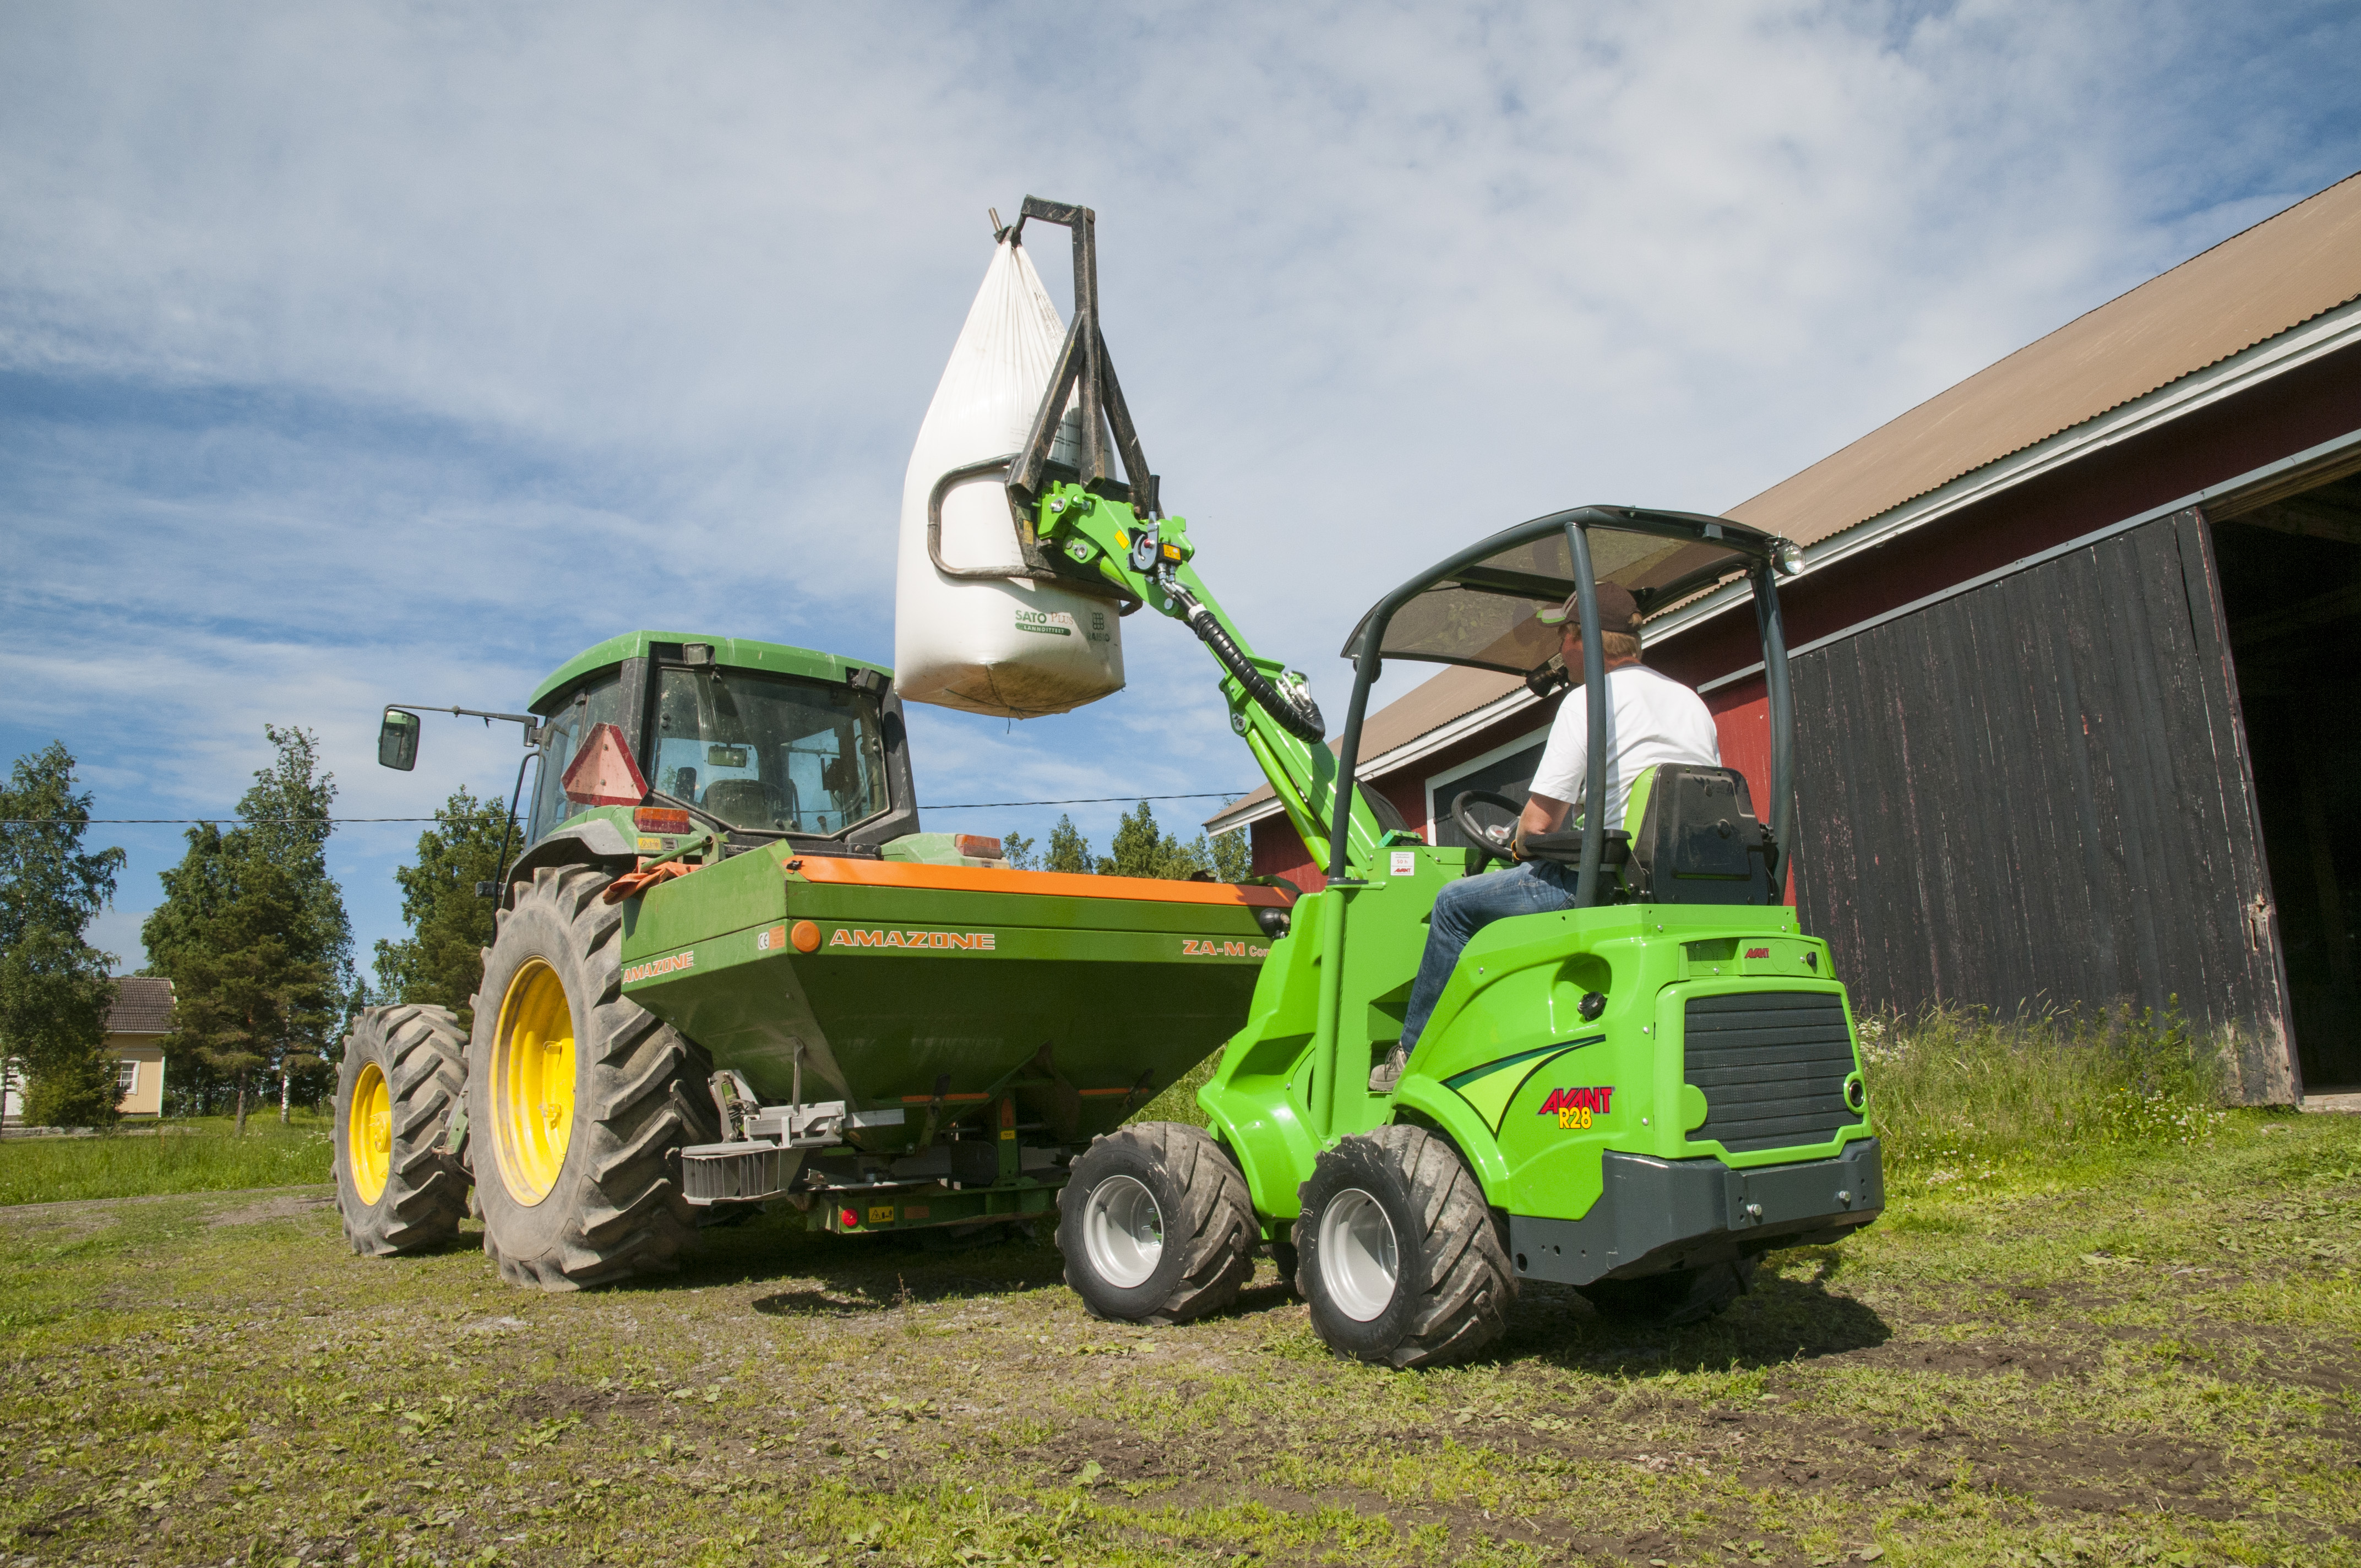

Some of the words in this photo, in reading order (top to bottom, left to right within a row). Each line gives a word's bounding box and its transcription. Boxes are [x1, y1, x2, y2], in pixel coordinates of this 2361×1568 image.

[1015, 609, 1047, 624] SATO
[1024, 625, 1064, 634] LANNOITTEET
[829, 929, 995, 950] AMAZONE
[1183, 940, 1245, 956] ZA-M
[1744, 948, 1769, 959] AVANT
[622, 951, 694, 984] AMAZONE
[1536, 1086, 1613, 1115] AVANT
[1559, 1107, 1592, 1129] R28
